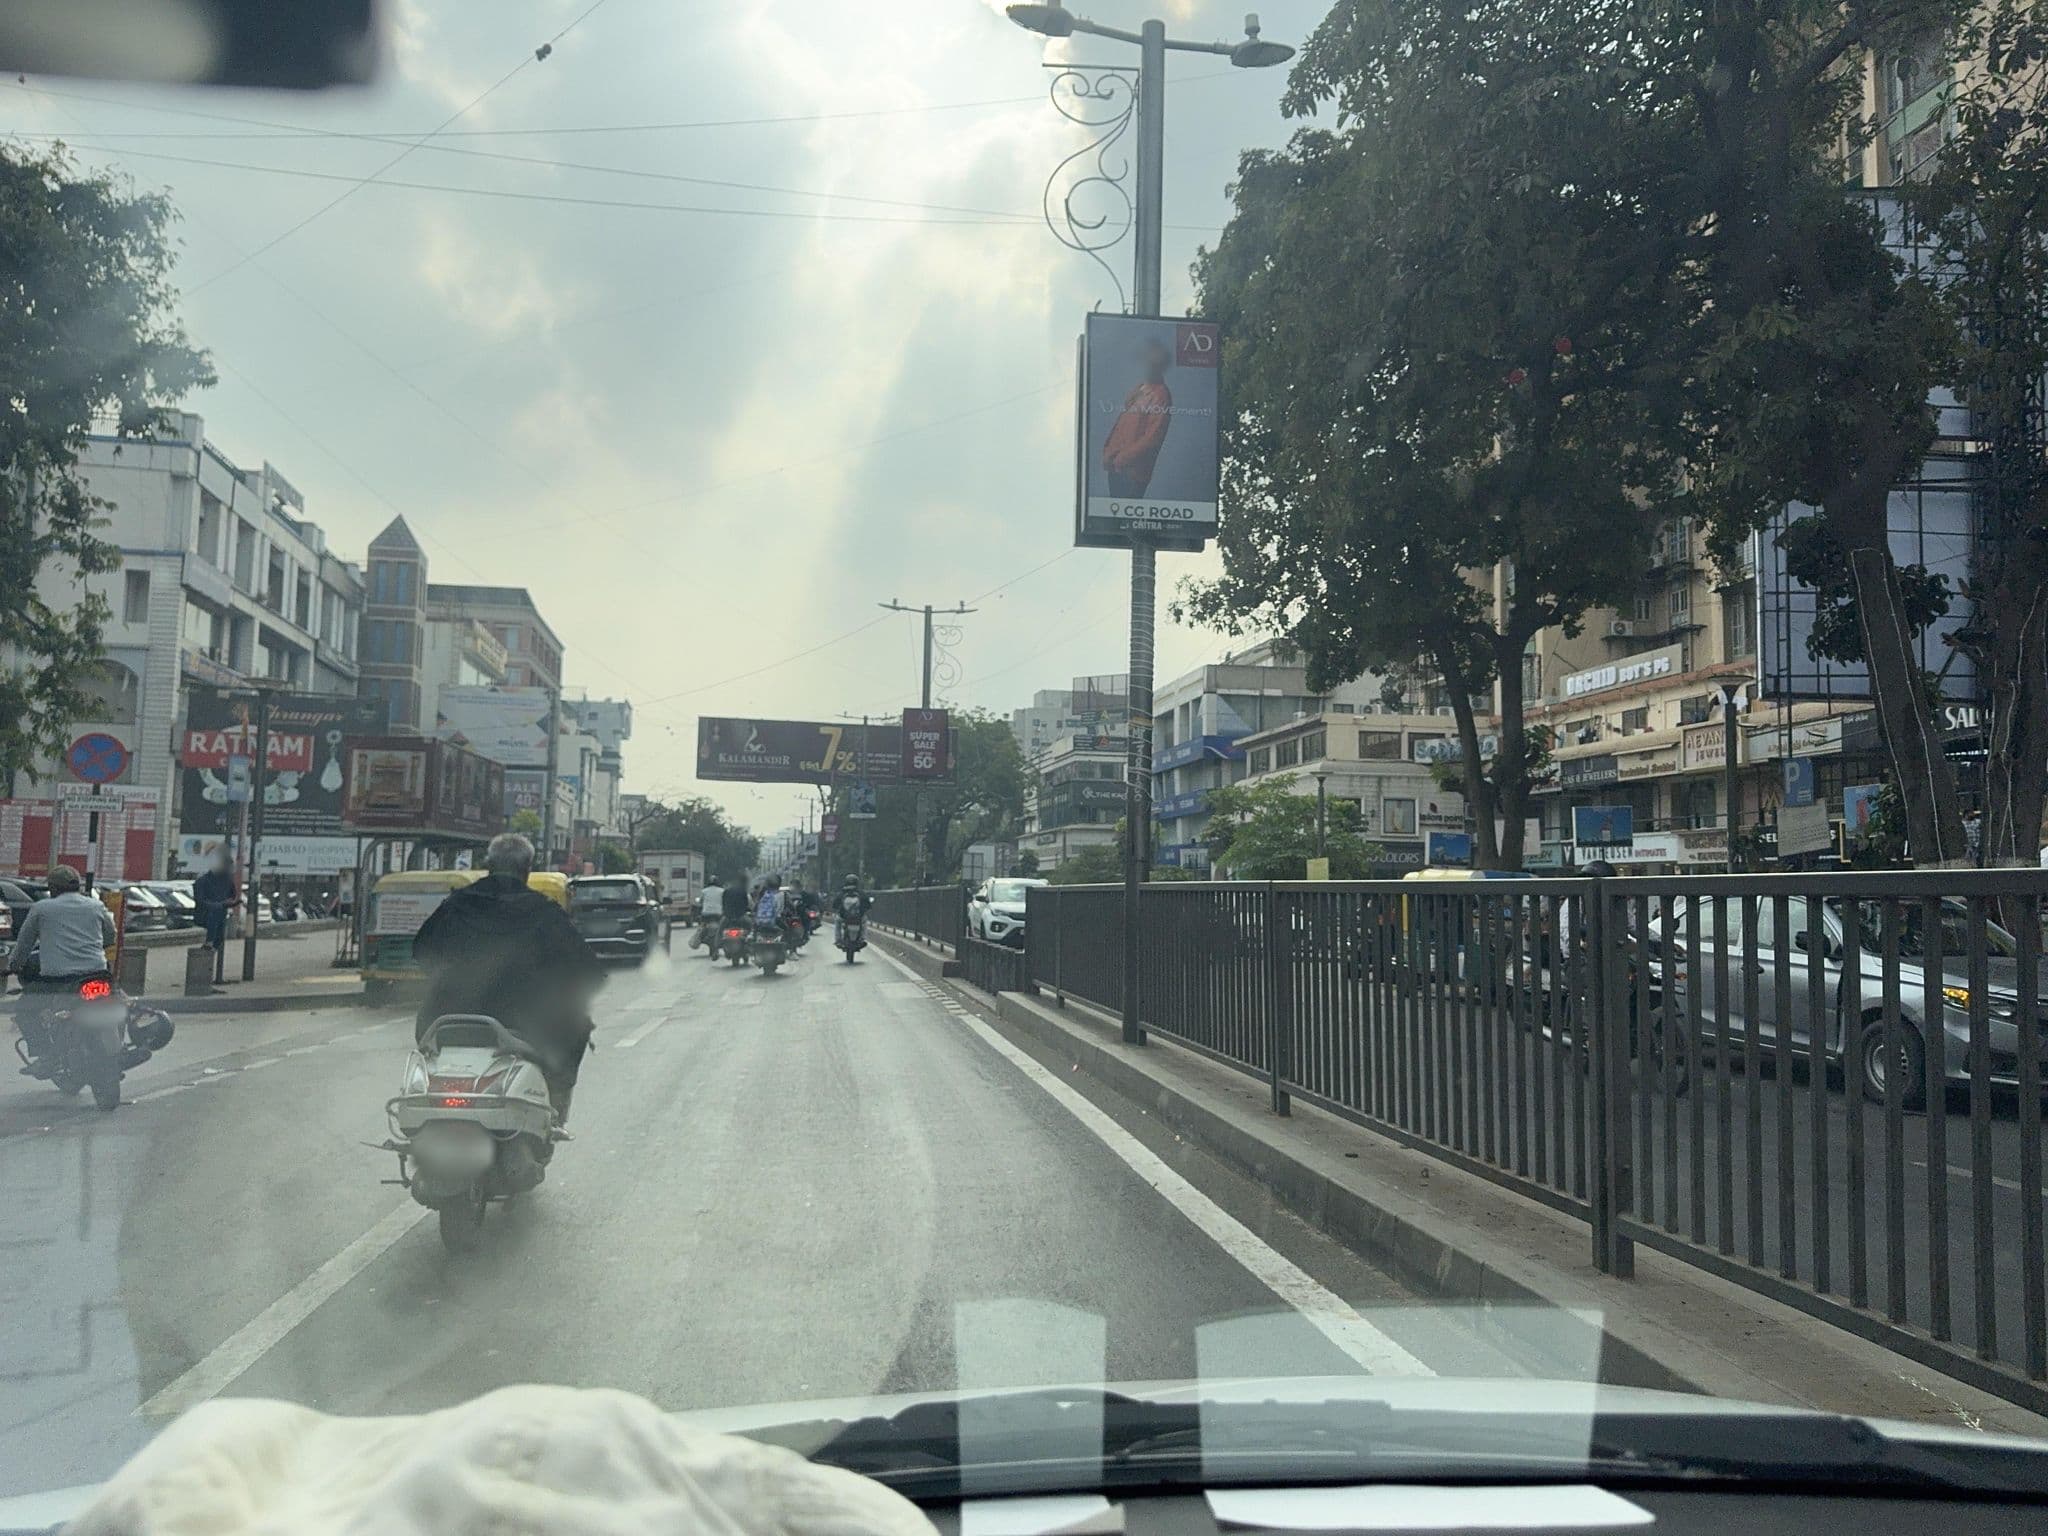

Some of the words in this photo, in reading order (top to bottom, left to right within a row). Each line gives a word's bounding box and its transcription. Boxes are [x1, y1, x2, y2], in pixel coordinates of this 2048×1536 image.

[1124, 505, 1145, 517] CG
[1149, 506, 1194, 519] ROAD
[1566, 666, 1616, 695] ORCHID
[910, 731, 940, 741] SUPER
[914, 741, 936, 750] SALE
[718, 753, 791, 766] KALAMANDIR
[1696, 748, 1728, 762] JEWEL
[1785, 761, 1800, 794] P
